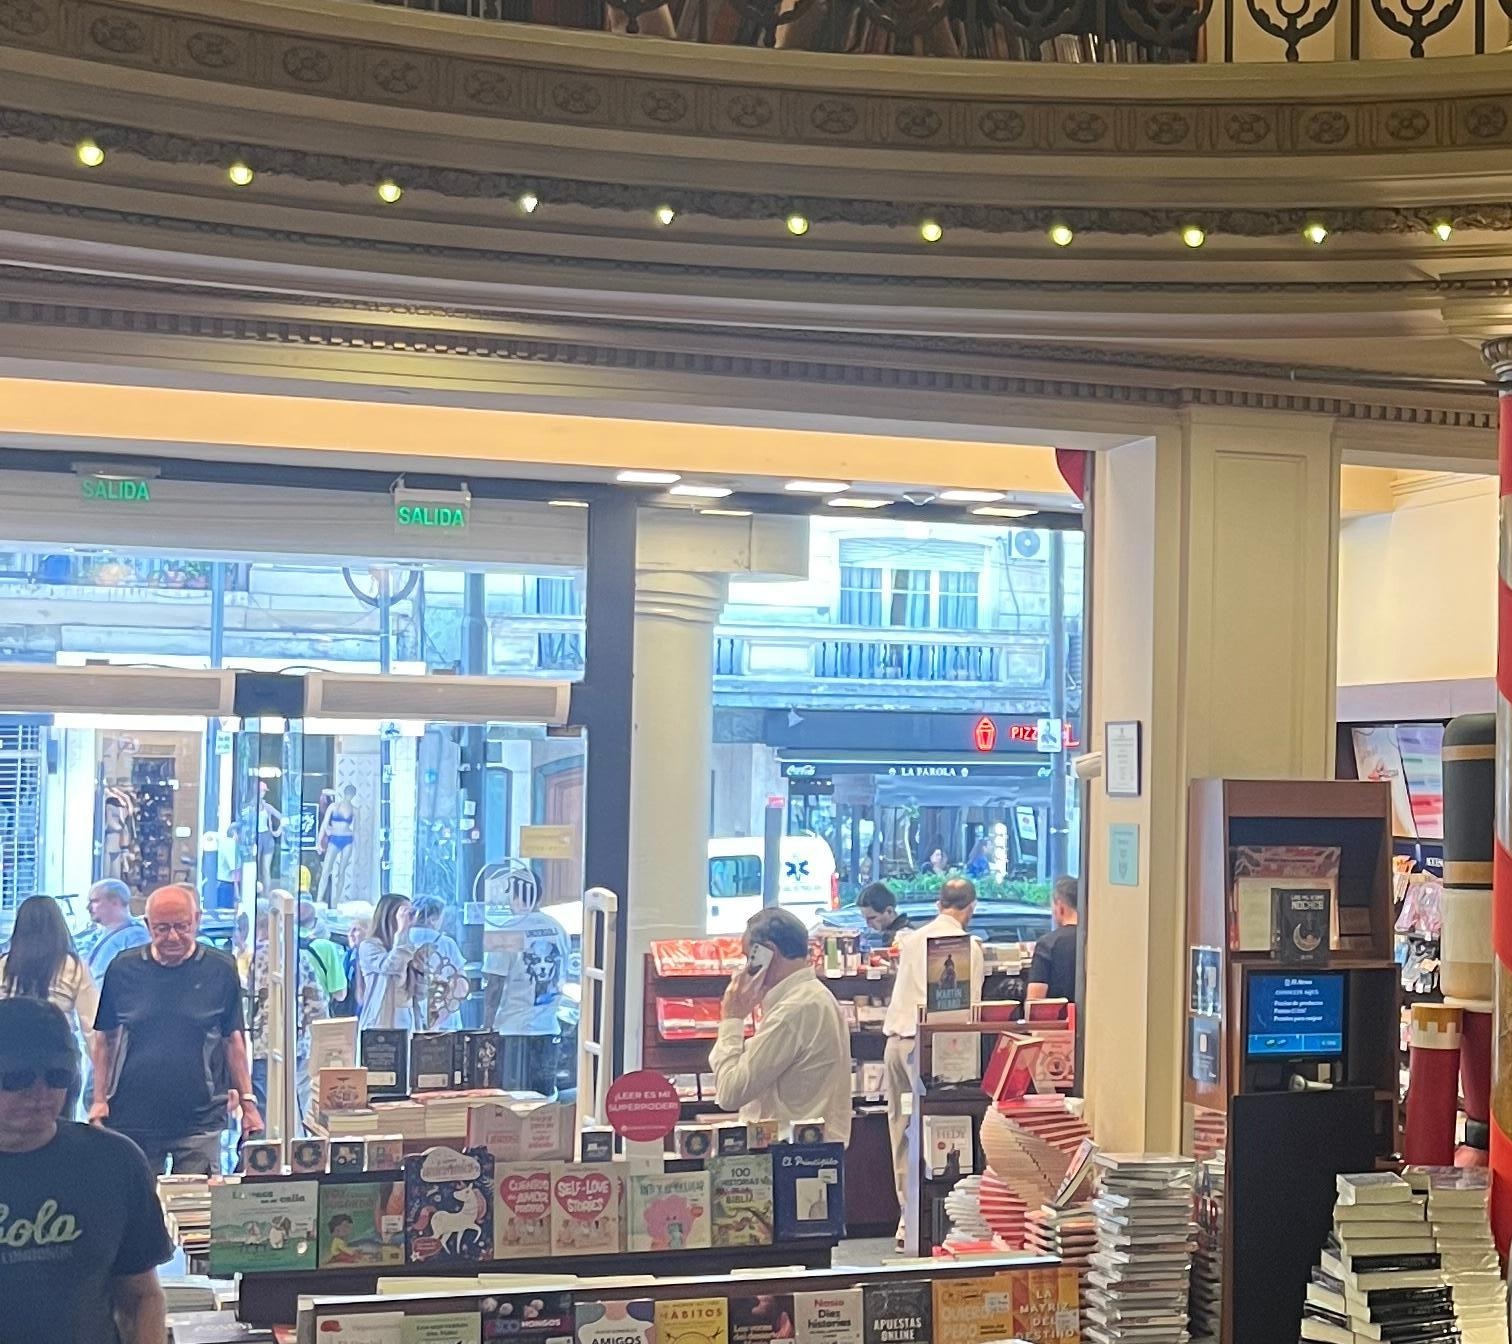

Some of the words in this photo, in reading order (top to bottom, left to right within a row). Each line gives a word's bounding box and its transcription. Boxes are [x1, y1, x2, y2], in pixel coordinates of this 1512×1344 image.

[81, 480, 150, 502] SALIDA
[398, 506, 465, 528] SALIDA
[901, 767, 914, 777] LA
[916, 767, 956, 777] PAROLA
[644, 1091, 656, 1100] ES
[658, 1090, 671, 1100] MI
[731, 1167, 750, 1178] 100
[557, 1179, 610, 1198] SELF-LOVE
[566, 1197, 604, 1214] STORIES
[1036, 1289, 1052, 1299] LA
[1019, 1302, 1070, 1314] MATRIZ
[873, 1317, 923, 1333] APUESTAS
[880, 1329, 916, 1343] ONLINE
